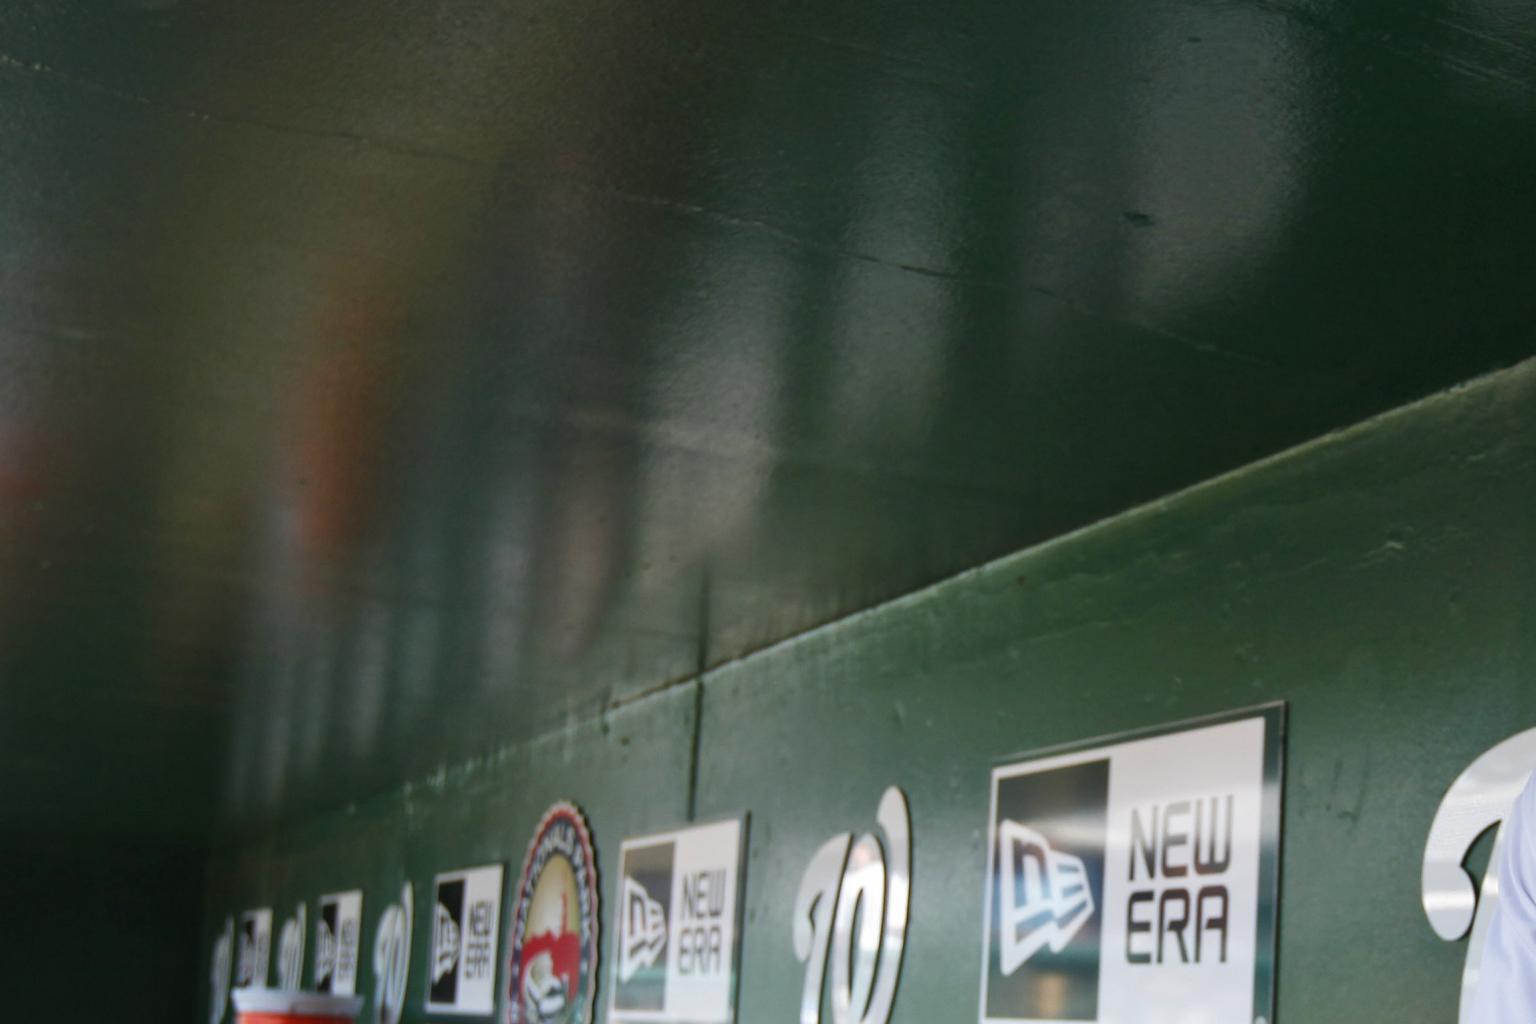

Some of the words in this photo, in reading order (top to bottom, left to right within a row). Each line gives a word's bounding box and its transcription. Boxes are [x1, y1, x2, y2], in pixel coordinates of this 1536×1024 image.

[1128, 795, 1234, 882] NEW
[682, 867, 727, 920] NEW
[1126, 885, 1229, 964] ERA
[678, 926, 722, 976] ERA
